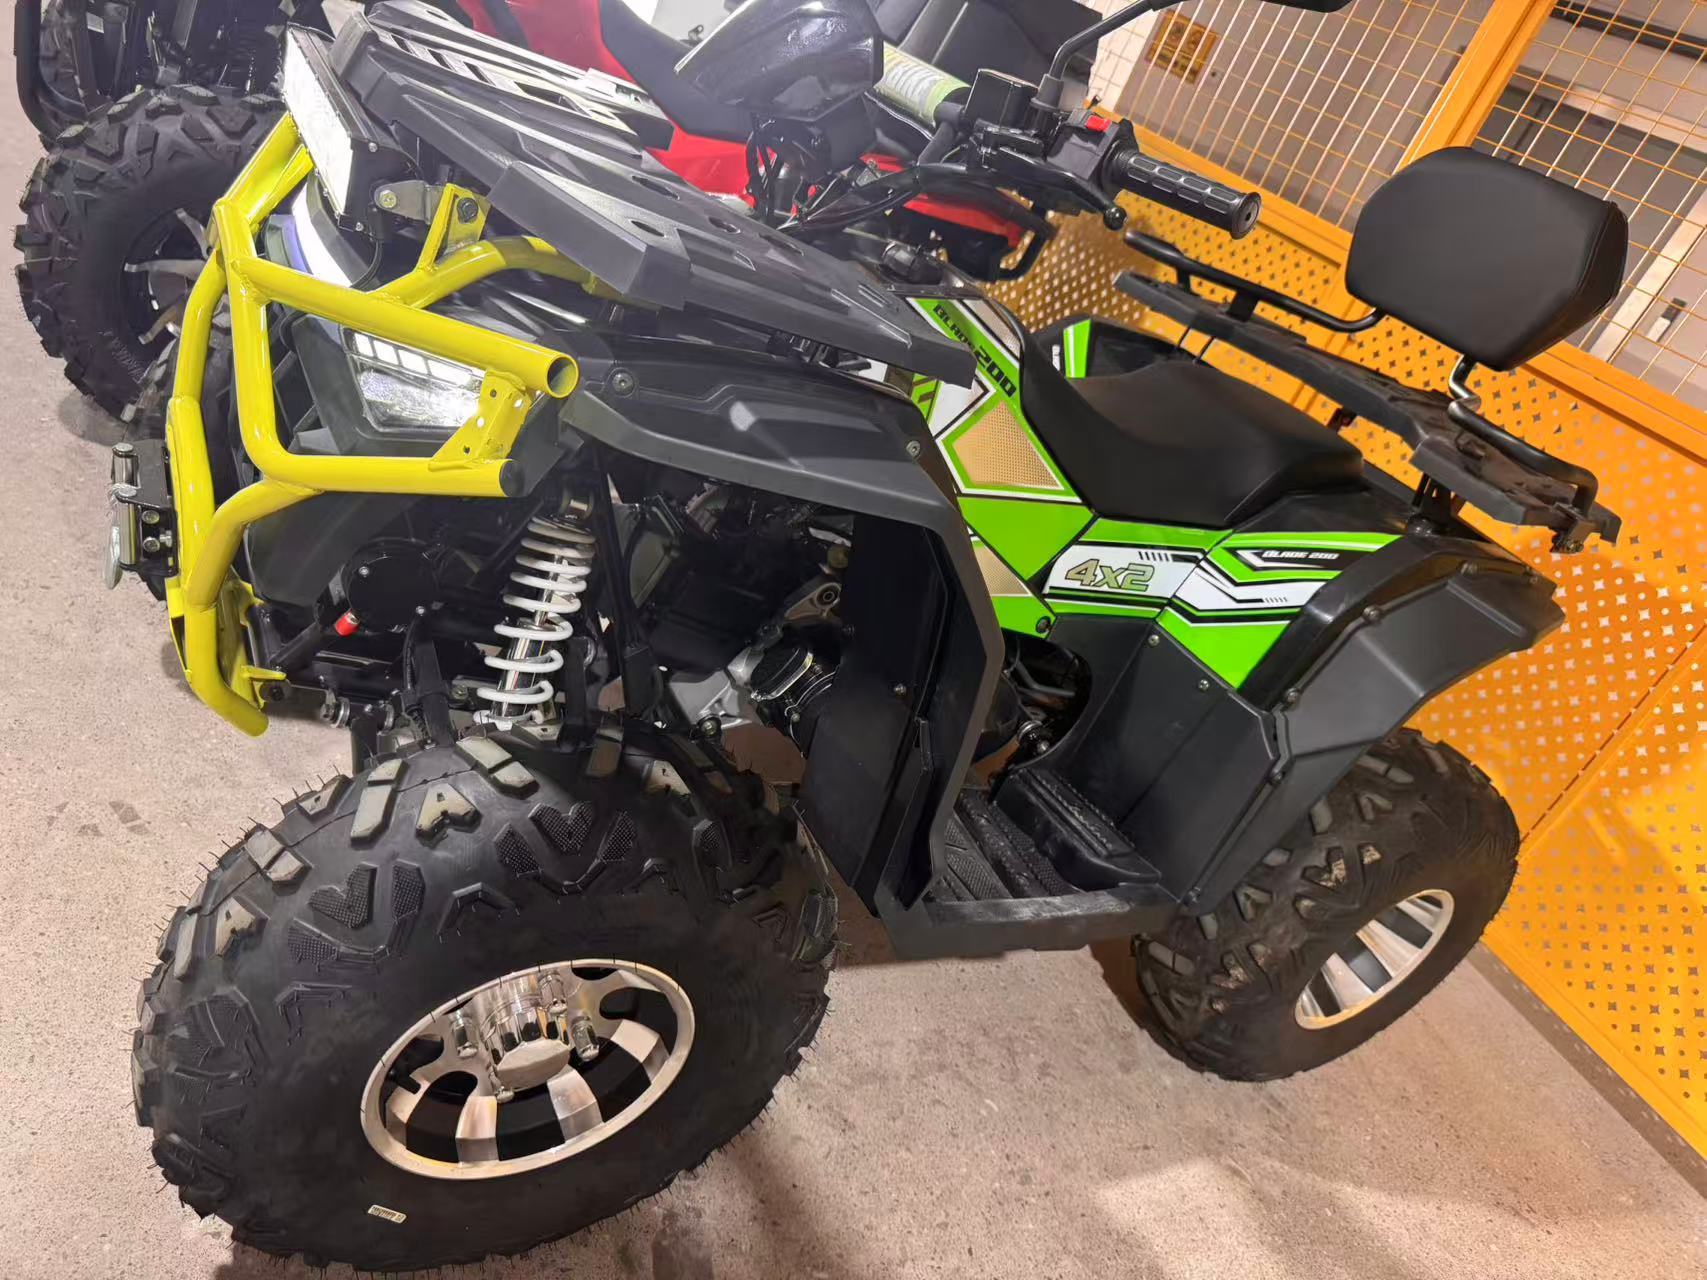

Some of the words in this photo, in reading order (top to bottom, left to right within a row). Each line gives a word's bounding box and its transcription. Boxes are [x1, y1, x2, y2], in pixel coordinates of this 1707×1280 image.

[974, 346, 1017, 398] 200
[1261, 549, 1310, 559] BLADE
[1308, 551, 1340, 560] 200
[1065, 558, 1155, 593] 4x2
